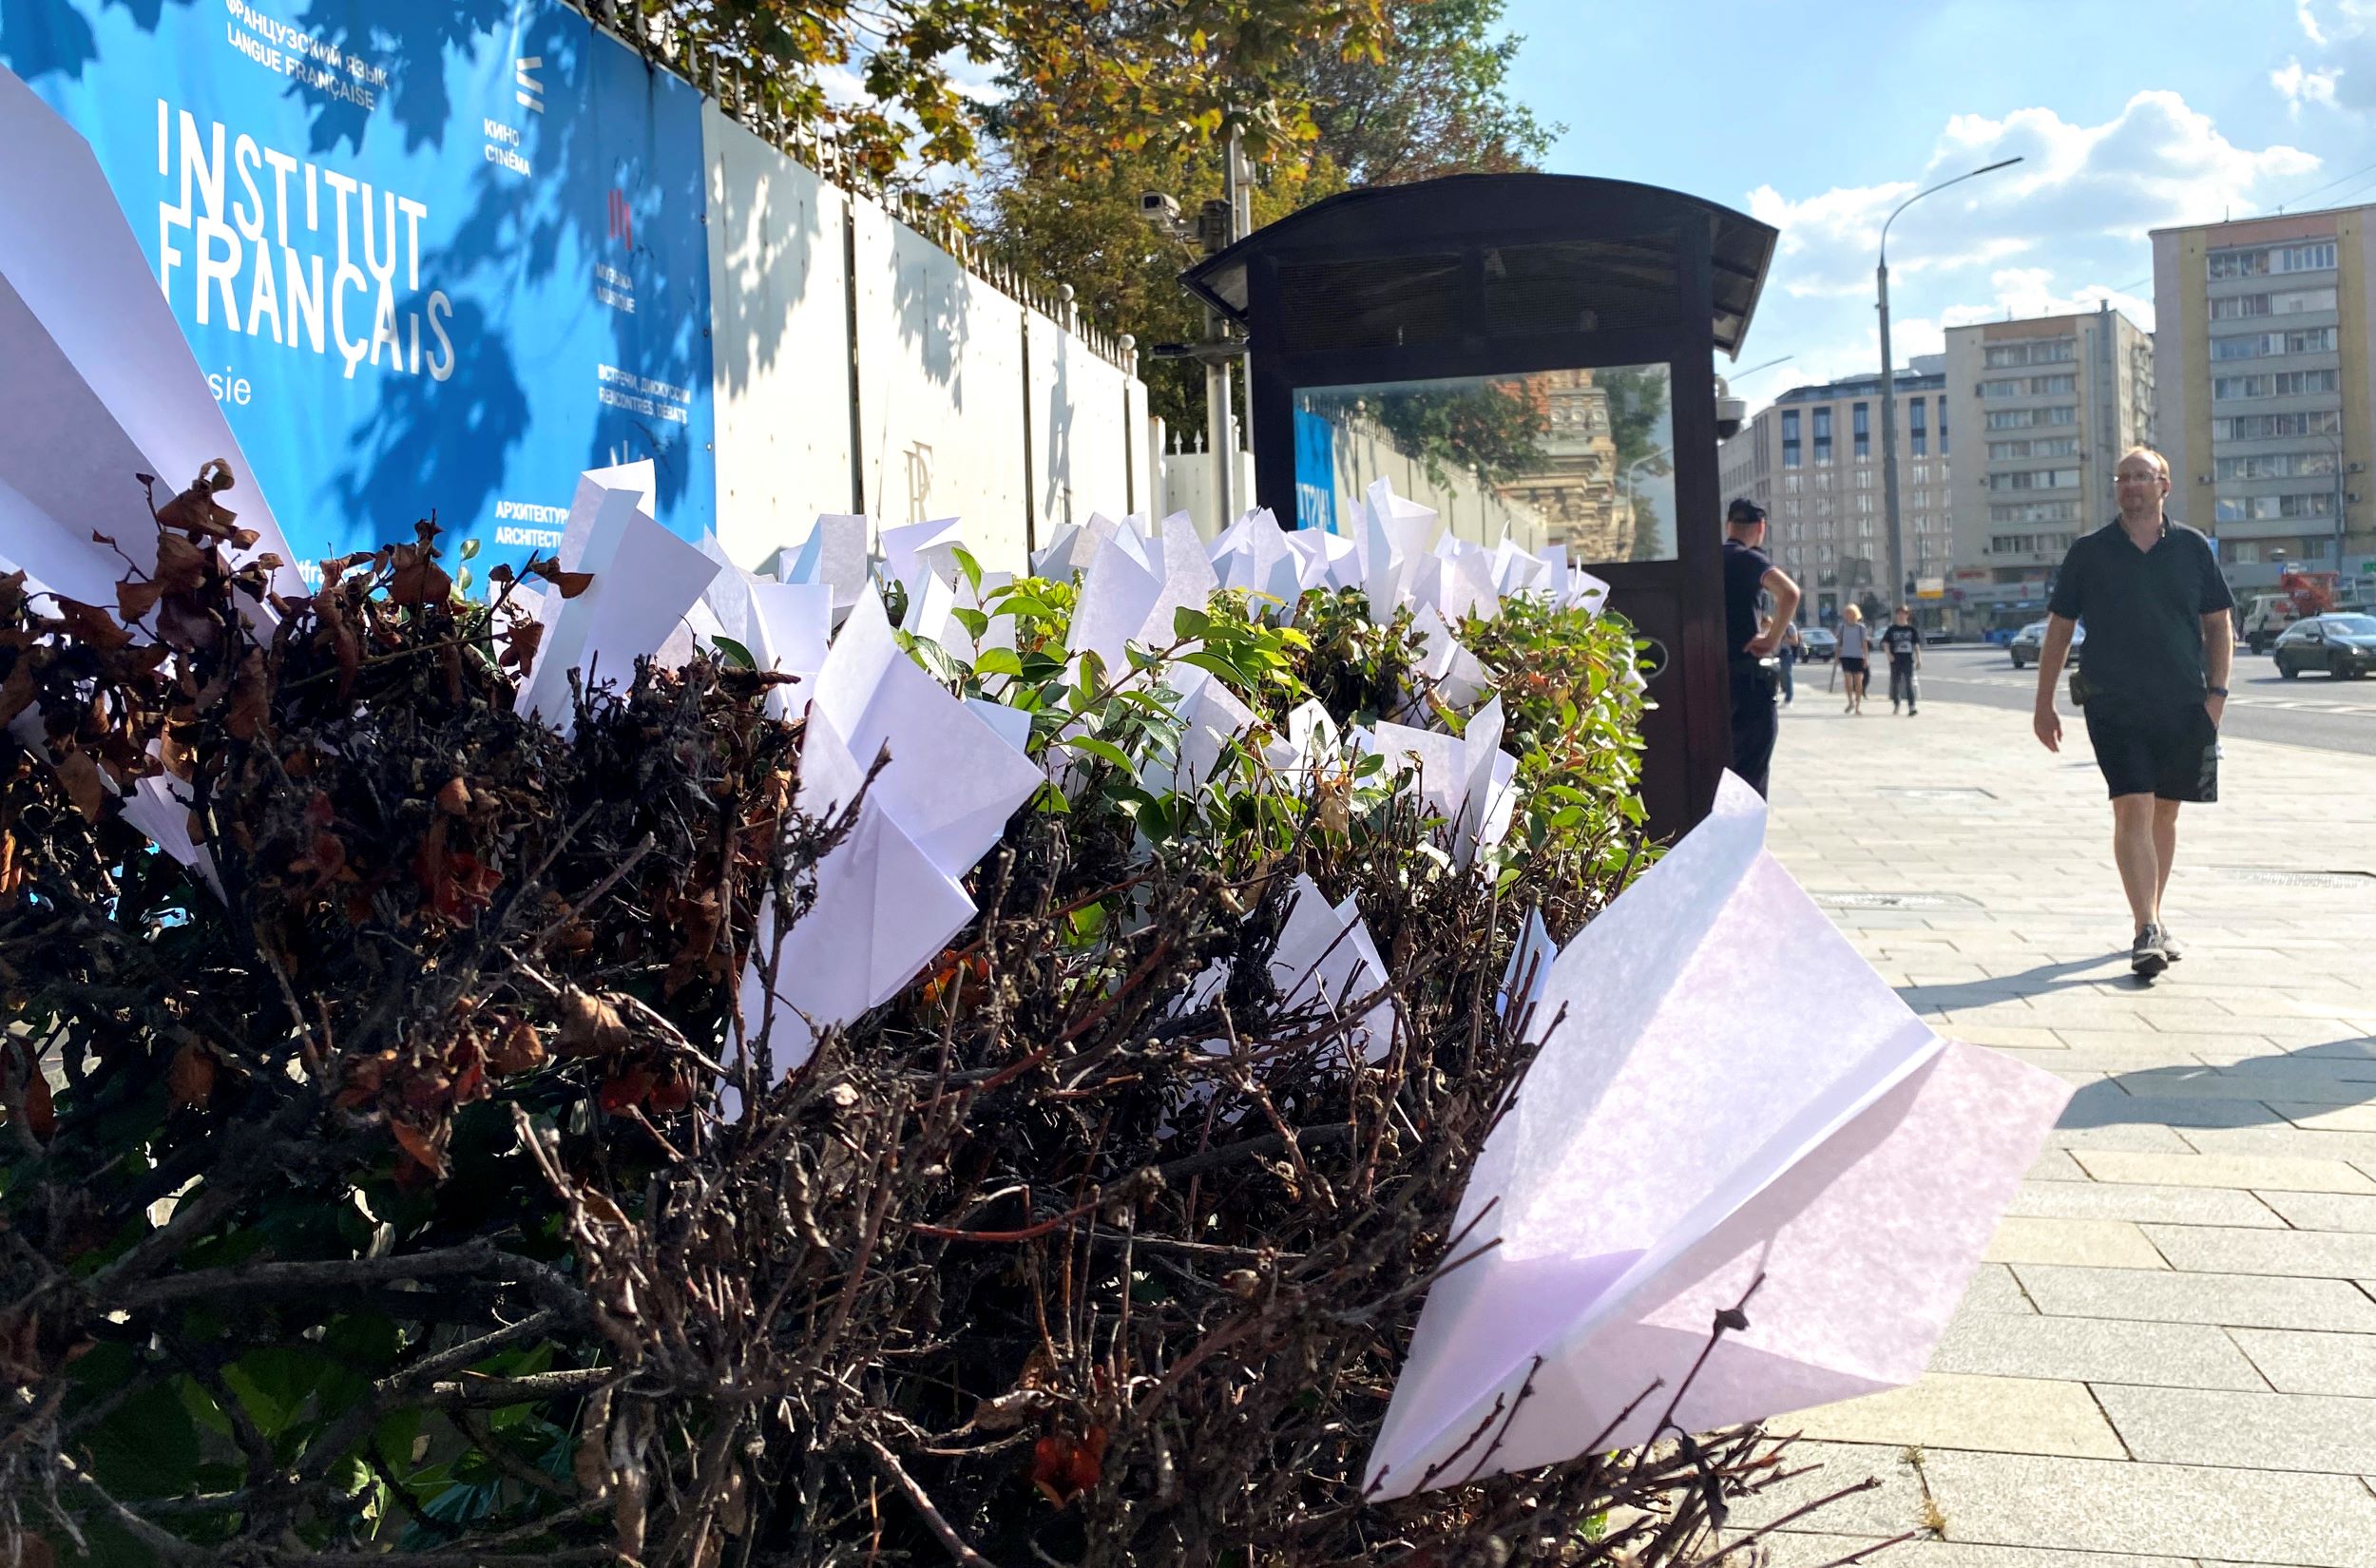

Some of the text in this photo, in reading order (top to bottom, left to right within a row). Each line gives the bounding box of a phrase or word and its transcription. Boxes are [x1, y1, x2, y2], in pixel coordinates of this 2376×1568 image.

[225, 0, 389, 90] ФРАНЦУЗСКИЙ ЯЗЫК
[227, 21, 374, 111] LANGUE FRANÇAISE
[484, 118, 520, 147] КИНО
[485, 144, 532, 178] CINÉMA
[157, 98, 428, 291] INSTITUT
[495, 500, 570, 526] АРХИТЕКТУР
